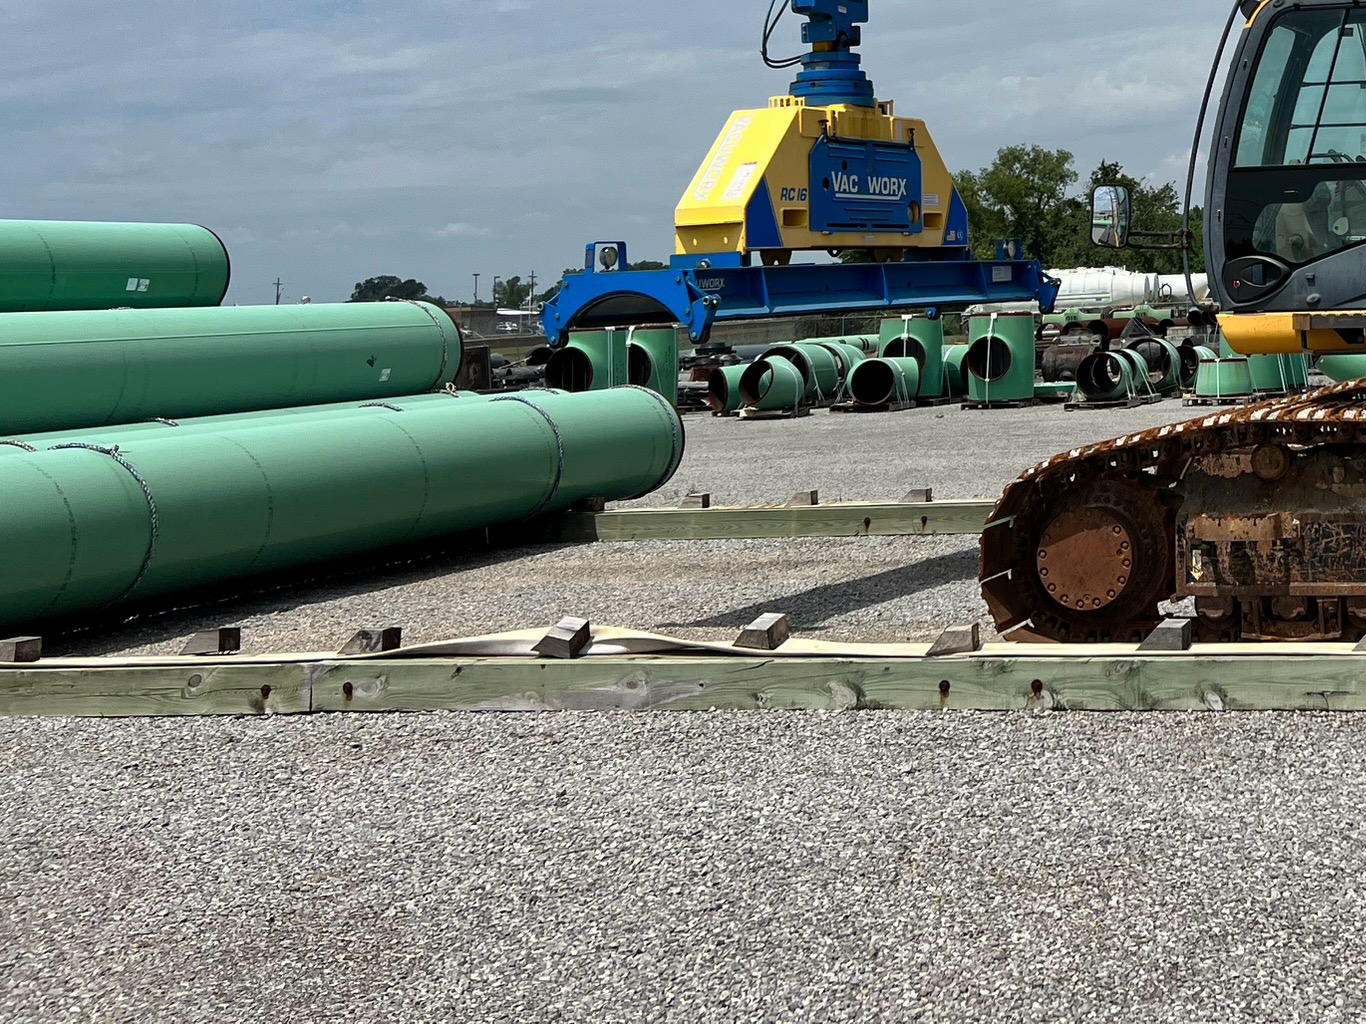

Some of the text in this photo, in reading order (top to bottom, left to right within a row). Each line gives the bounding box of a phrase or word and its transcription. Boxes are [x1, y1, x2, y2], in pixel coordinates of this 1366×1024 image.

[694, 113, 756, 202] VACUWORX
[831, 171, 908, 196] VAC WORX
[780, 187, 808, 202] RC 16
[696, 278, 726, 289] UWORX
